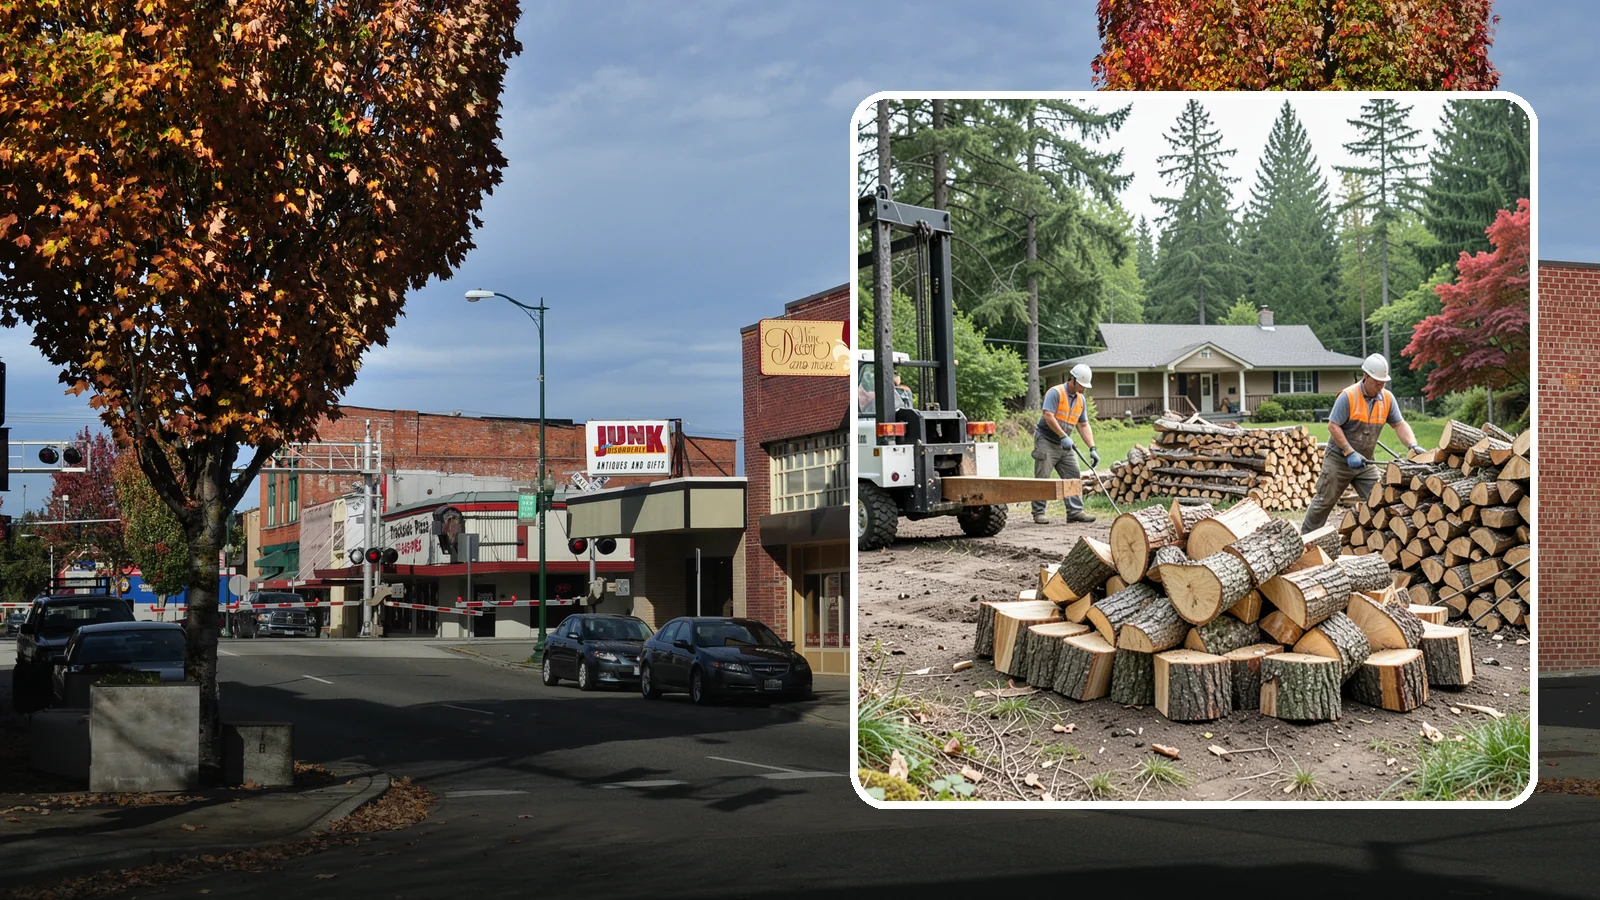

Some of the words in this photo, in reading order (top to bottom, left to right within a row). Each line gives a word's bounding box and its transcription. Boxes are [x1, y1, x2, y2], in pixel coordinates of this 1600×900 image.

[595, 425, 665, 457] JUNK
[607, 446, 646, 454] DISORDERLY
[596, 461, 628, 470] ANTIQUES
[630, 461, 644, 470] AND
[646, 460, 665, 470] GIFTS
[415, 519, 429, 535] Pizza
